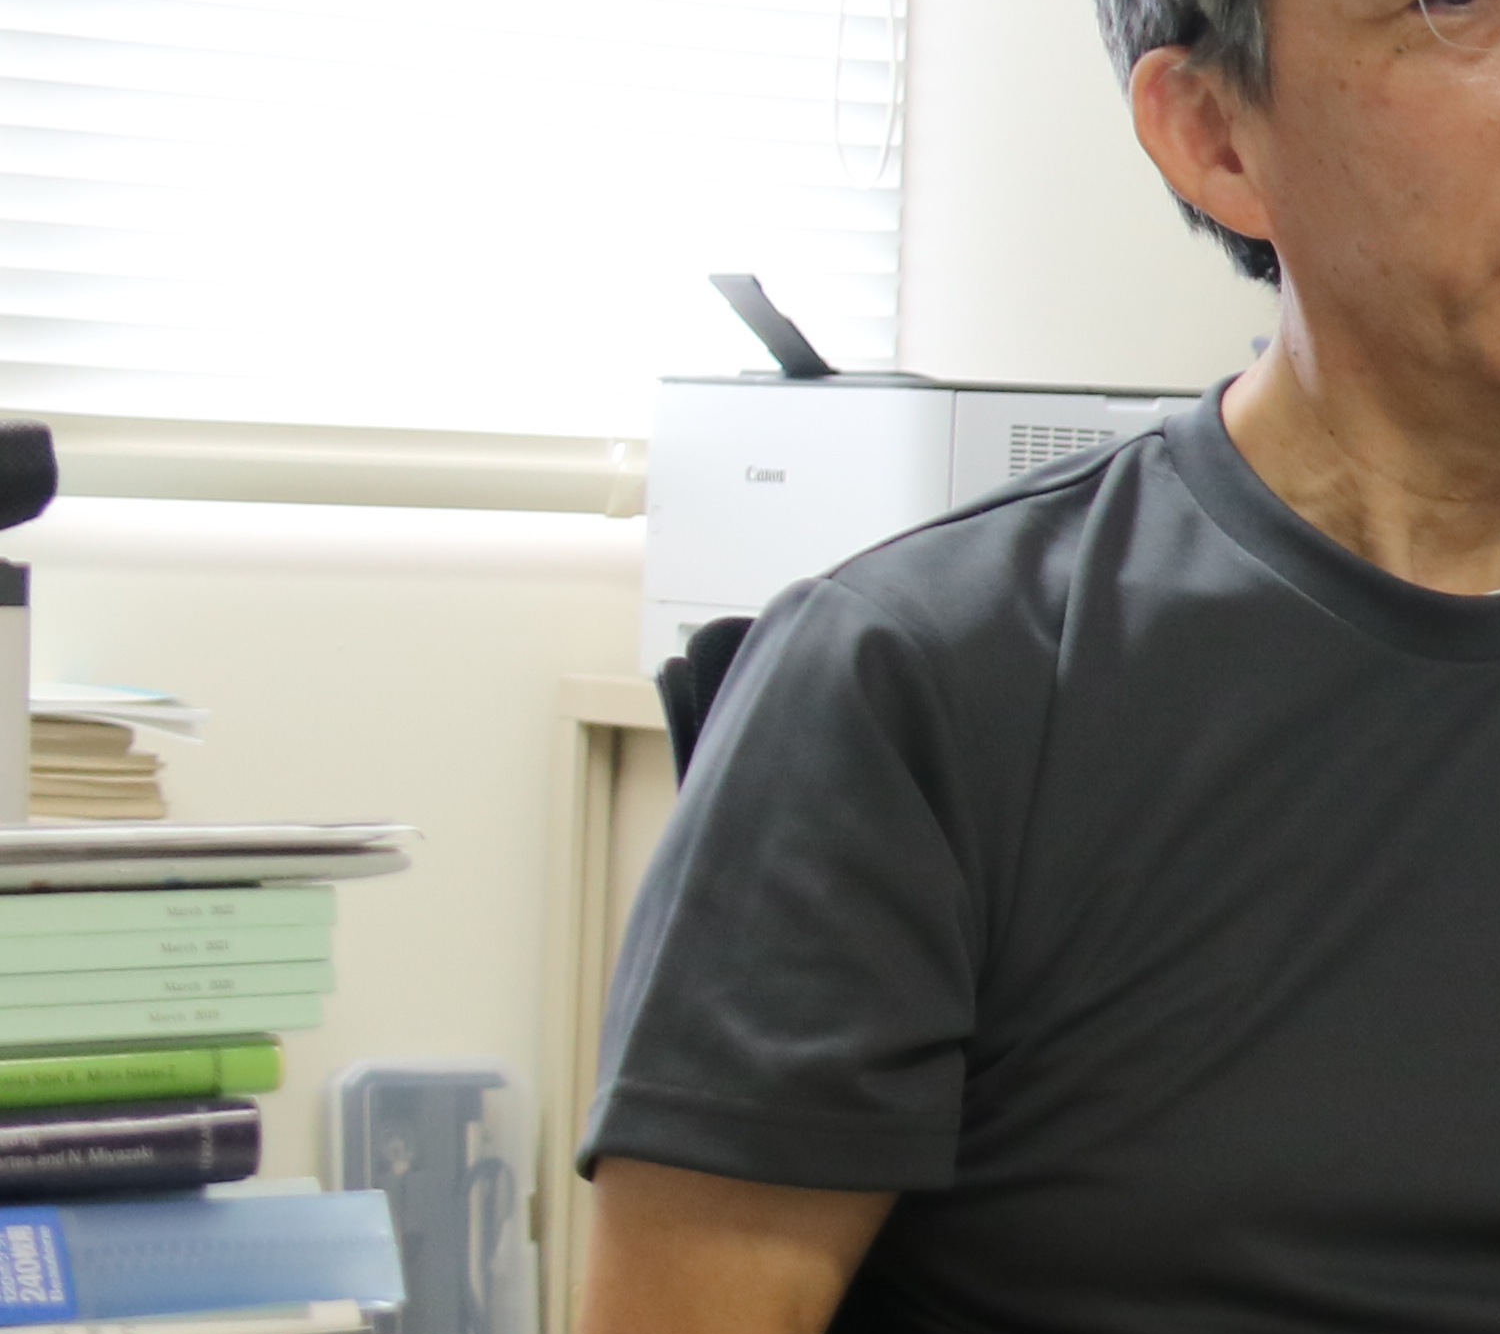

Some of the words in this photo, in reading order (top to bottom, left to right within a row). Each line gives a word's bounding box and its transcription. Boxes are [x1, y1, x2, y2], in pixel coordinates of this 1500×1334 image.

[745, 463, 787, 484] Canon
[166, 905, 203, 917] March
[160, 941, 197, 953] March
[164, 980, 201, 992] March
[148, 1010, 186, 1023] March
[38, 1150, 65, 1166] and
[88, 1145, 155, 1165] Miyazaki
